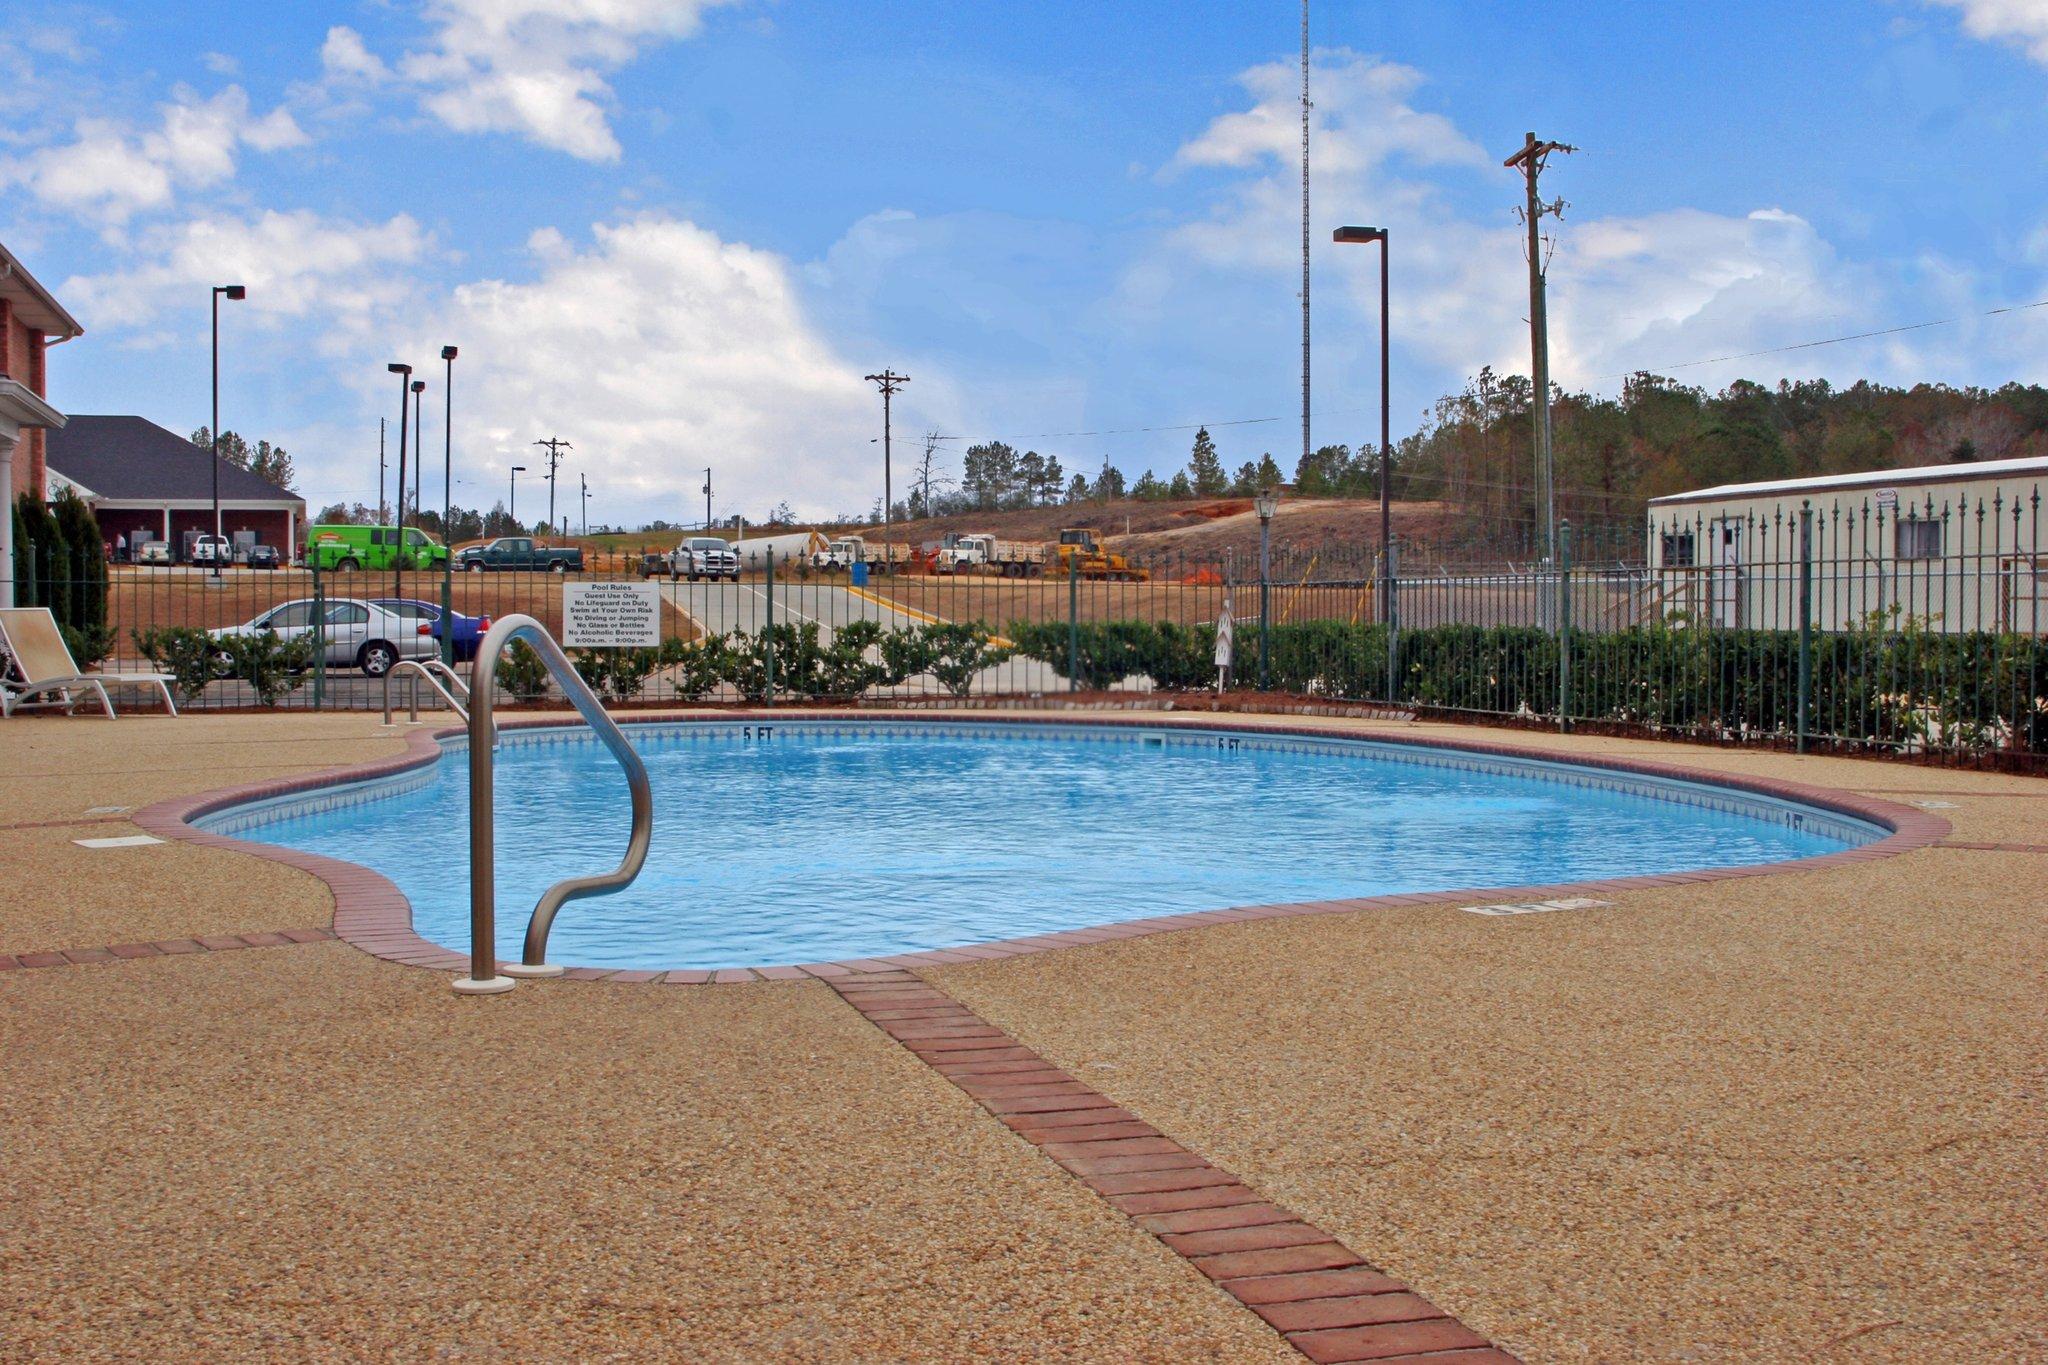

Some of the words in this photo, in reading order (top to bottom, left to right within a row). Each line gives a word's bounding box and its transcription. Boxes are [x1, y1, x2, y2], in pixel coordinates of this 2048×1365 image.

[744, 726, 751, 740] 5
[758, 726, 773, 740] FT
[1229, 738, 1240, 750] FT
